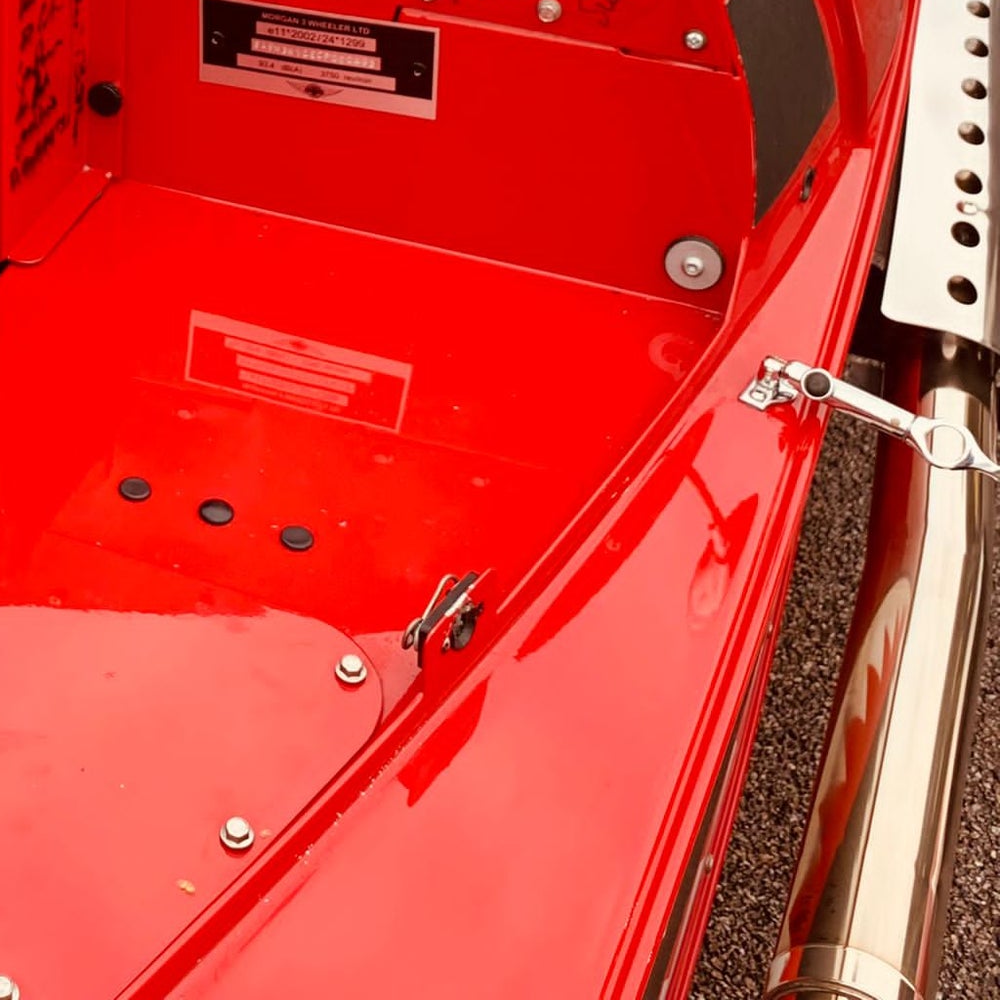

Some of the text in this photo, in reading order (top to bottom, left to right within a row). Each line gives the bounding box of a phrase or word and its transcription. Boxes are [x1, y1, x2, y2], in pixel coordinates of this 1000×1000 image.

[262, 11, 299, 25] MORGAN
[308, 19, 351, 33] WHEELER
[352, 26, 371, 35] LTD
